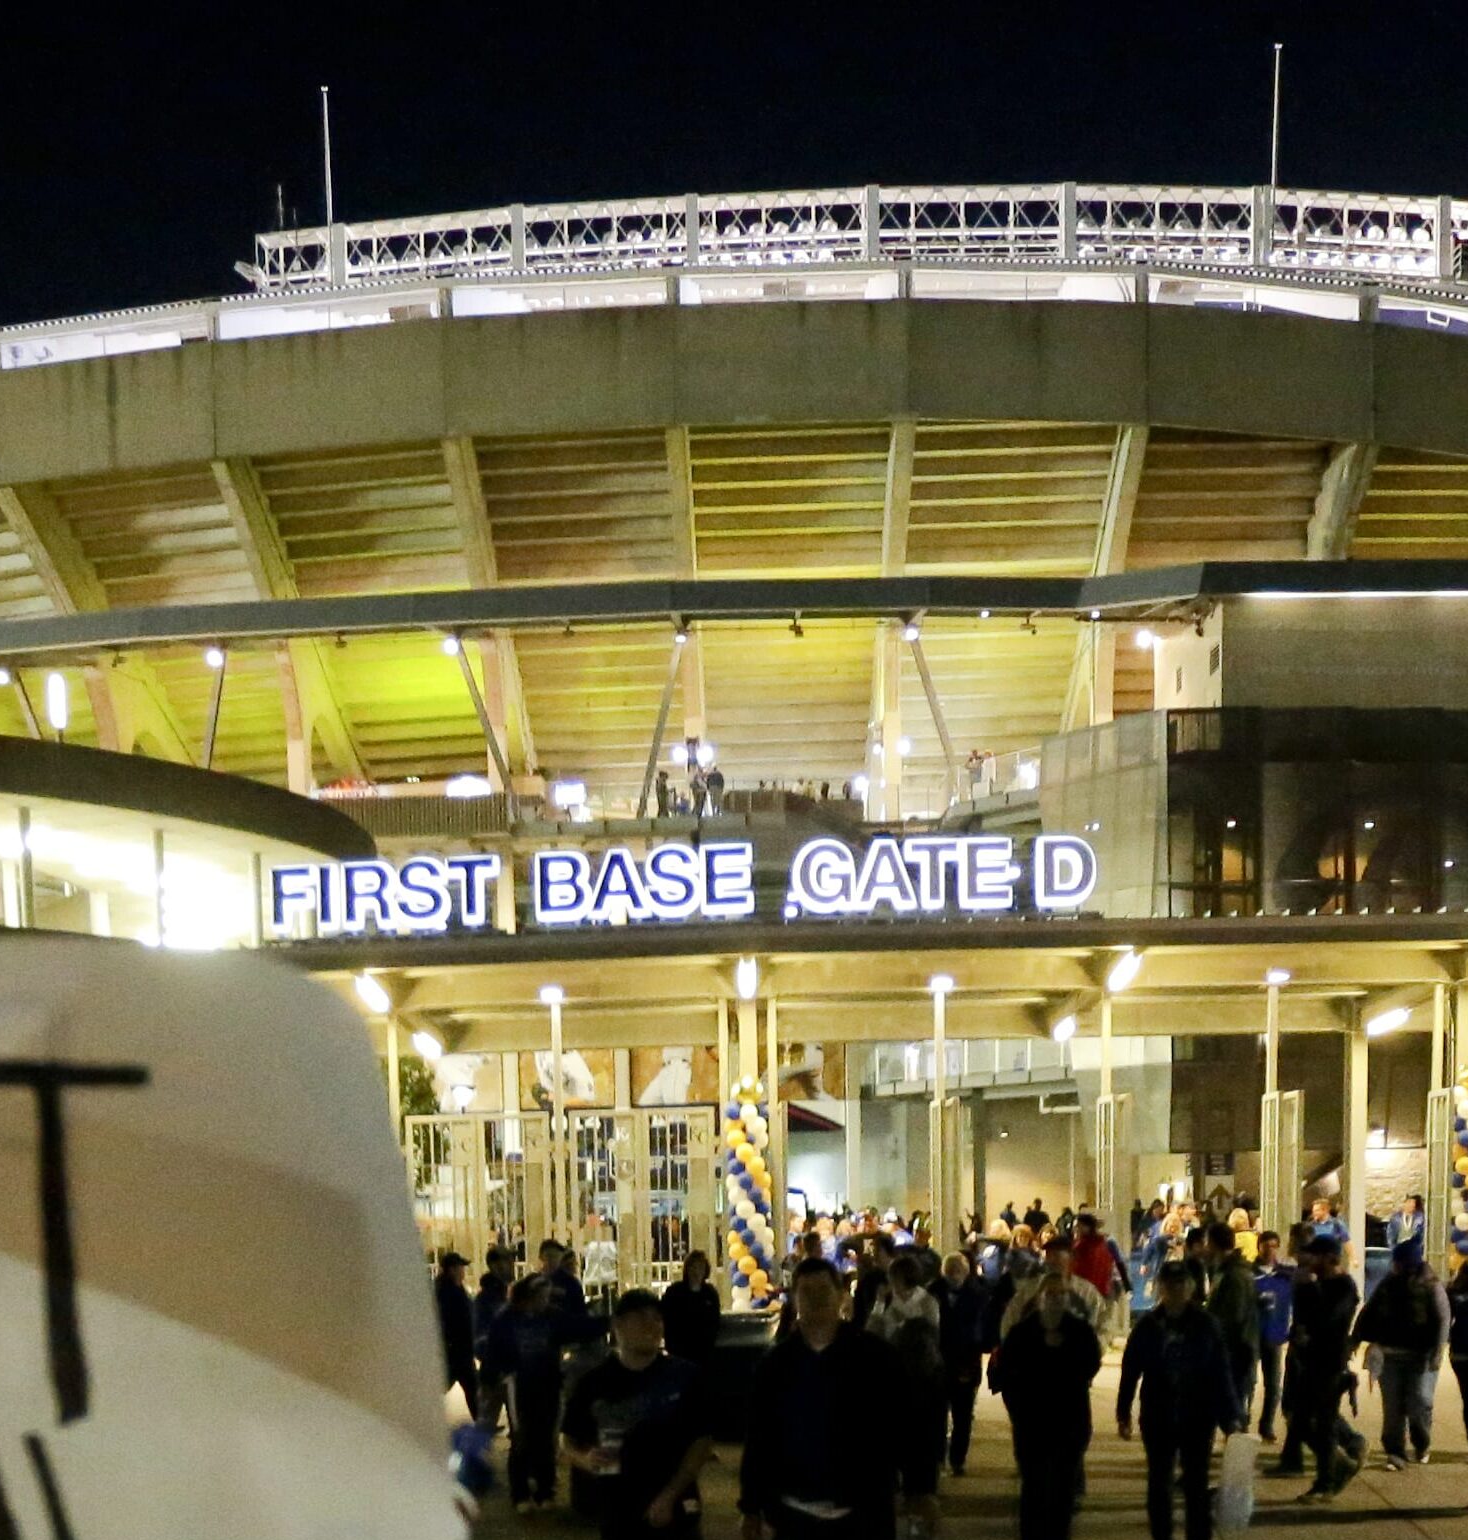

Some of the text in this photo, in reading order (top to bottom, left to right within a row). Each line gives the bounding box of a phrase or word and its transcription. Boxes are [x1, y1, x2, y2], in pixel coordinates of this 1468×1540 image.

[270, 834, 1098, 932] FIRST BASE GATE D
